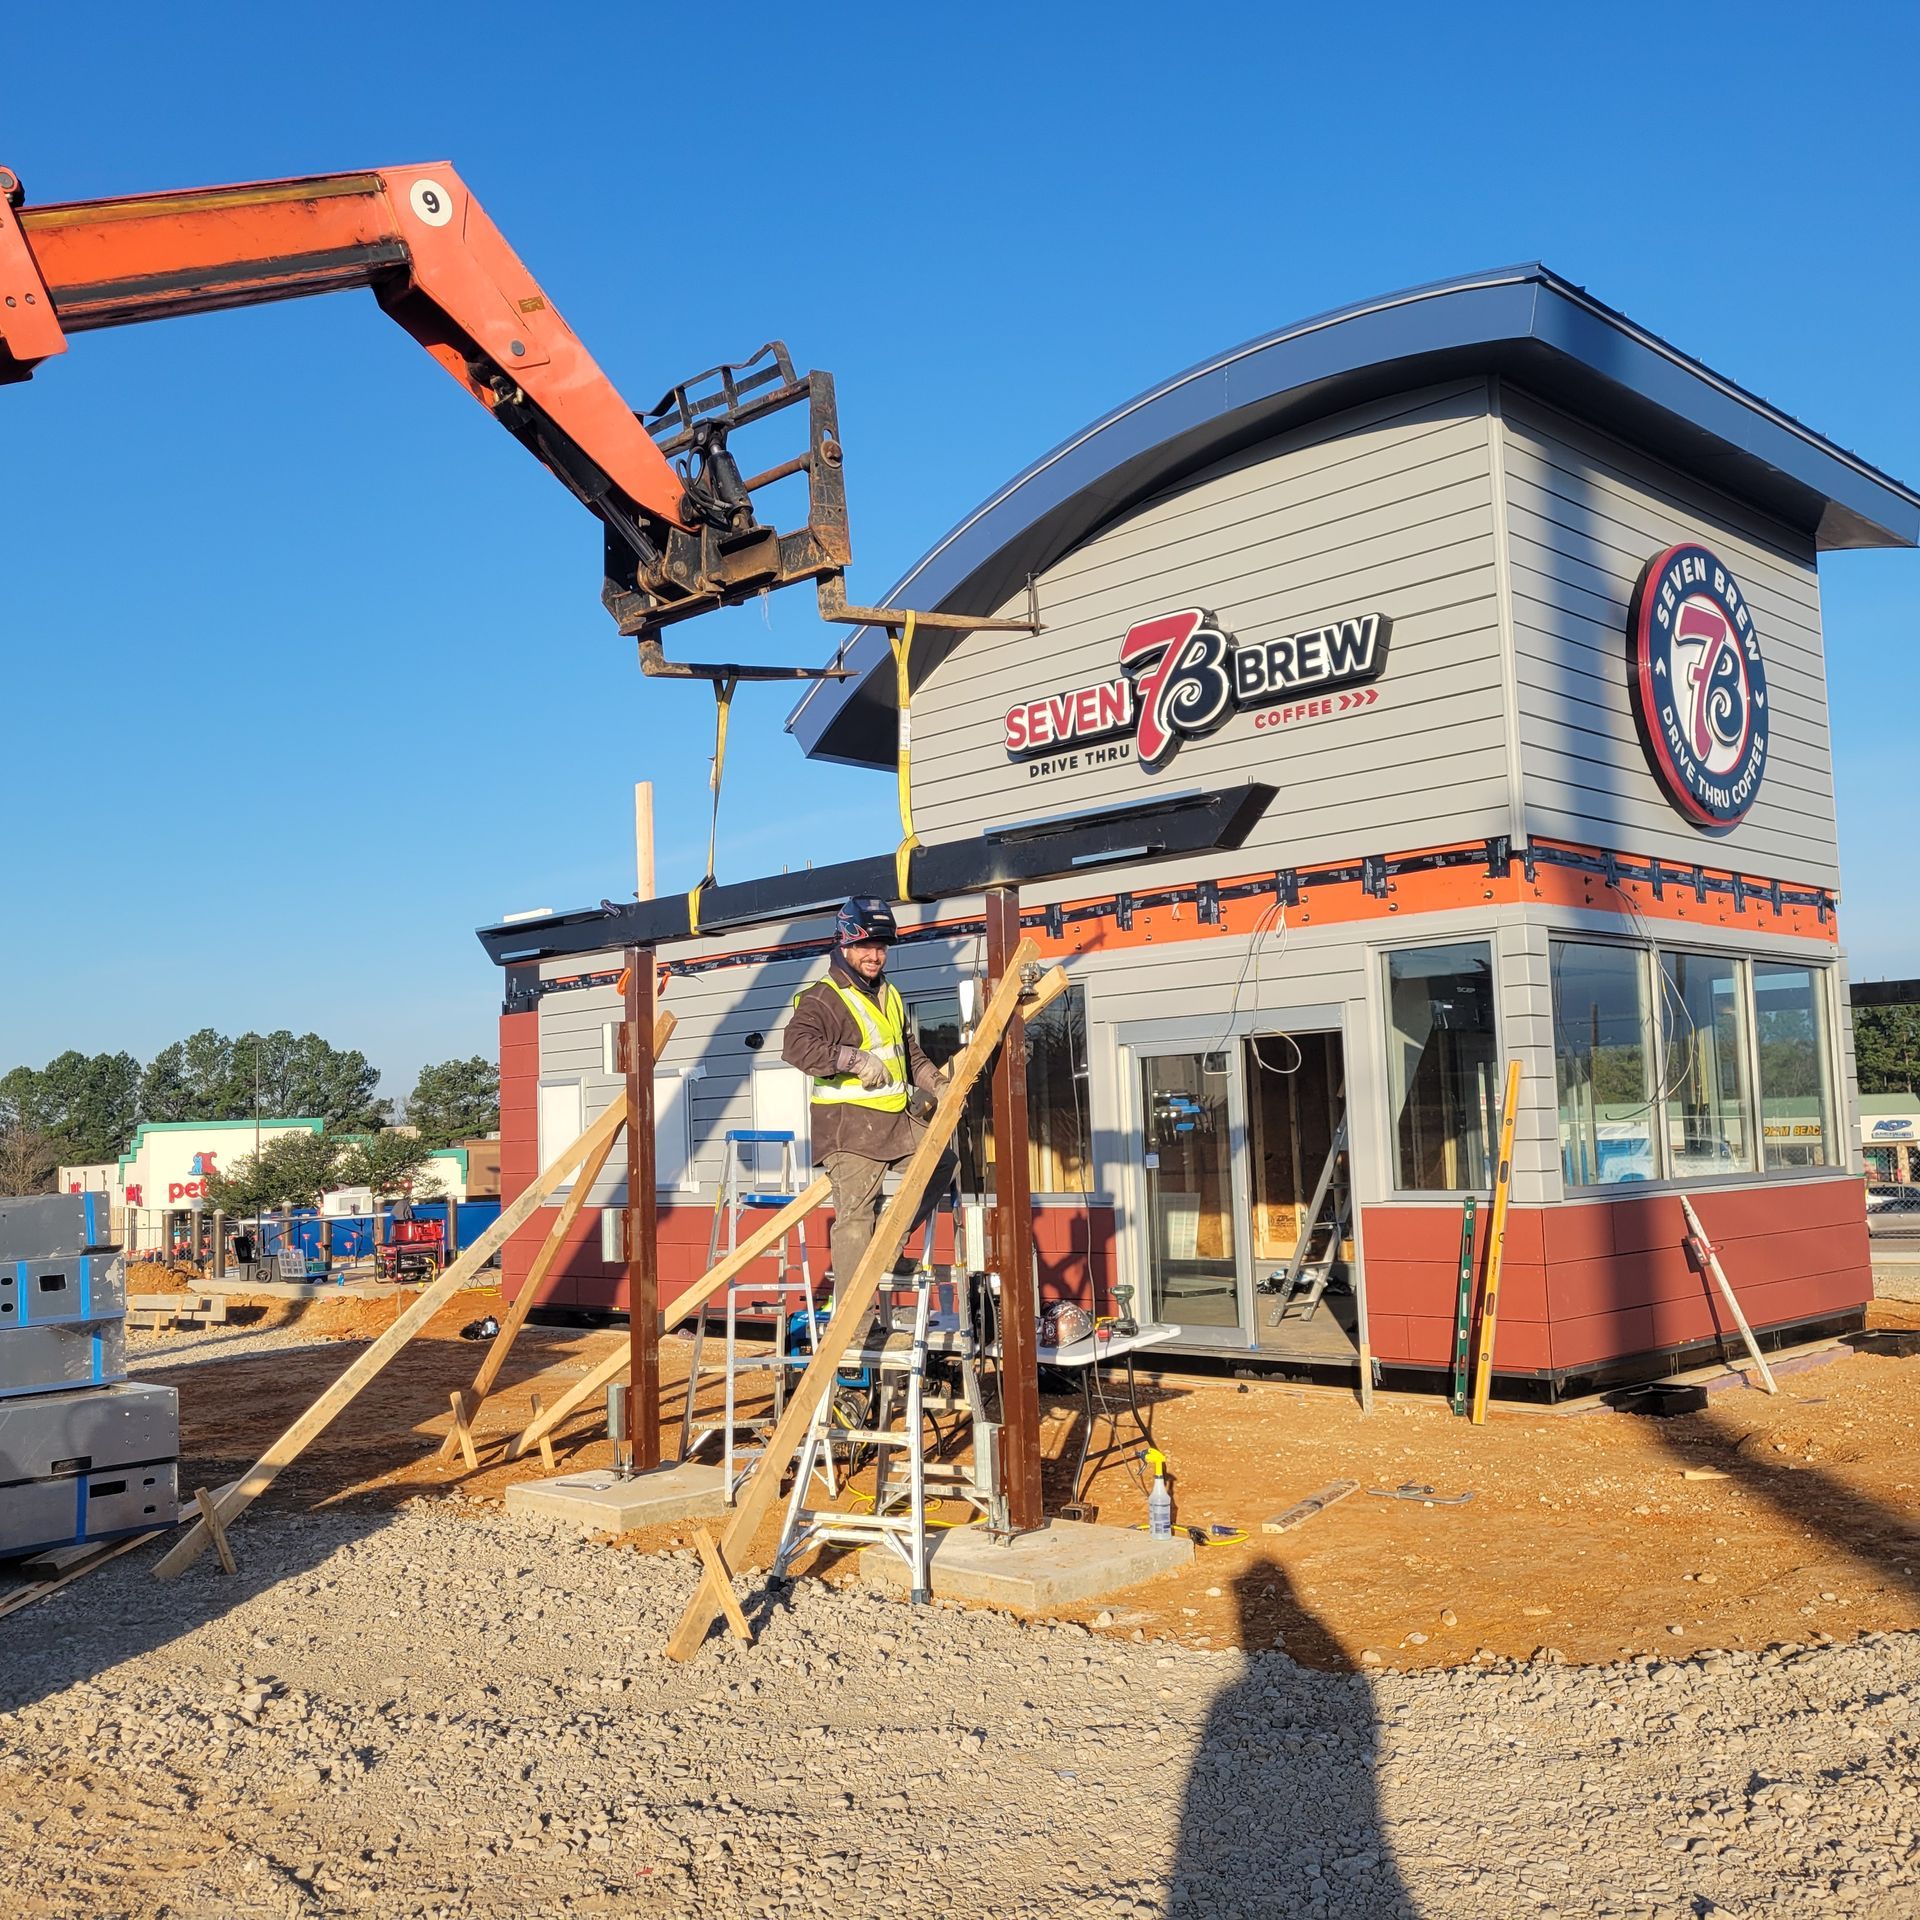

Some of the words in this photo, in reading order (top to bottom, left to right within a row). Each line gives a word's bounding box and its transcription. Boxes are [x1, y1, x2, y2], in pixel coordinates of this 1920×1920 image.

[422, 190, 440, 214] 9
[1657, 557, 1707, 631] SEVEN
[1715, 567, 1762, 662] BREW
[1005, 679, 1131, 751] SEVEN
[1236, 615, 1379, 698] BREW
[1254, 699, 1333, 729] COFFEE
[1030, 755, 1079, 779] DRIVE
[1085, 744, 1131, 766] THRU
[1662, 706, 1695, 784] DRIVE
[1697, 775, 1731, 809] THRU
[1732, 732, 1765, 804] COFFEE
[168, 1177, 209, 1204] pet
